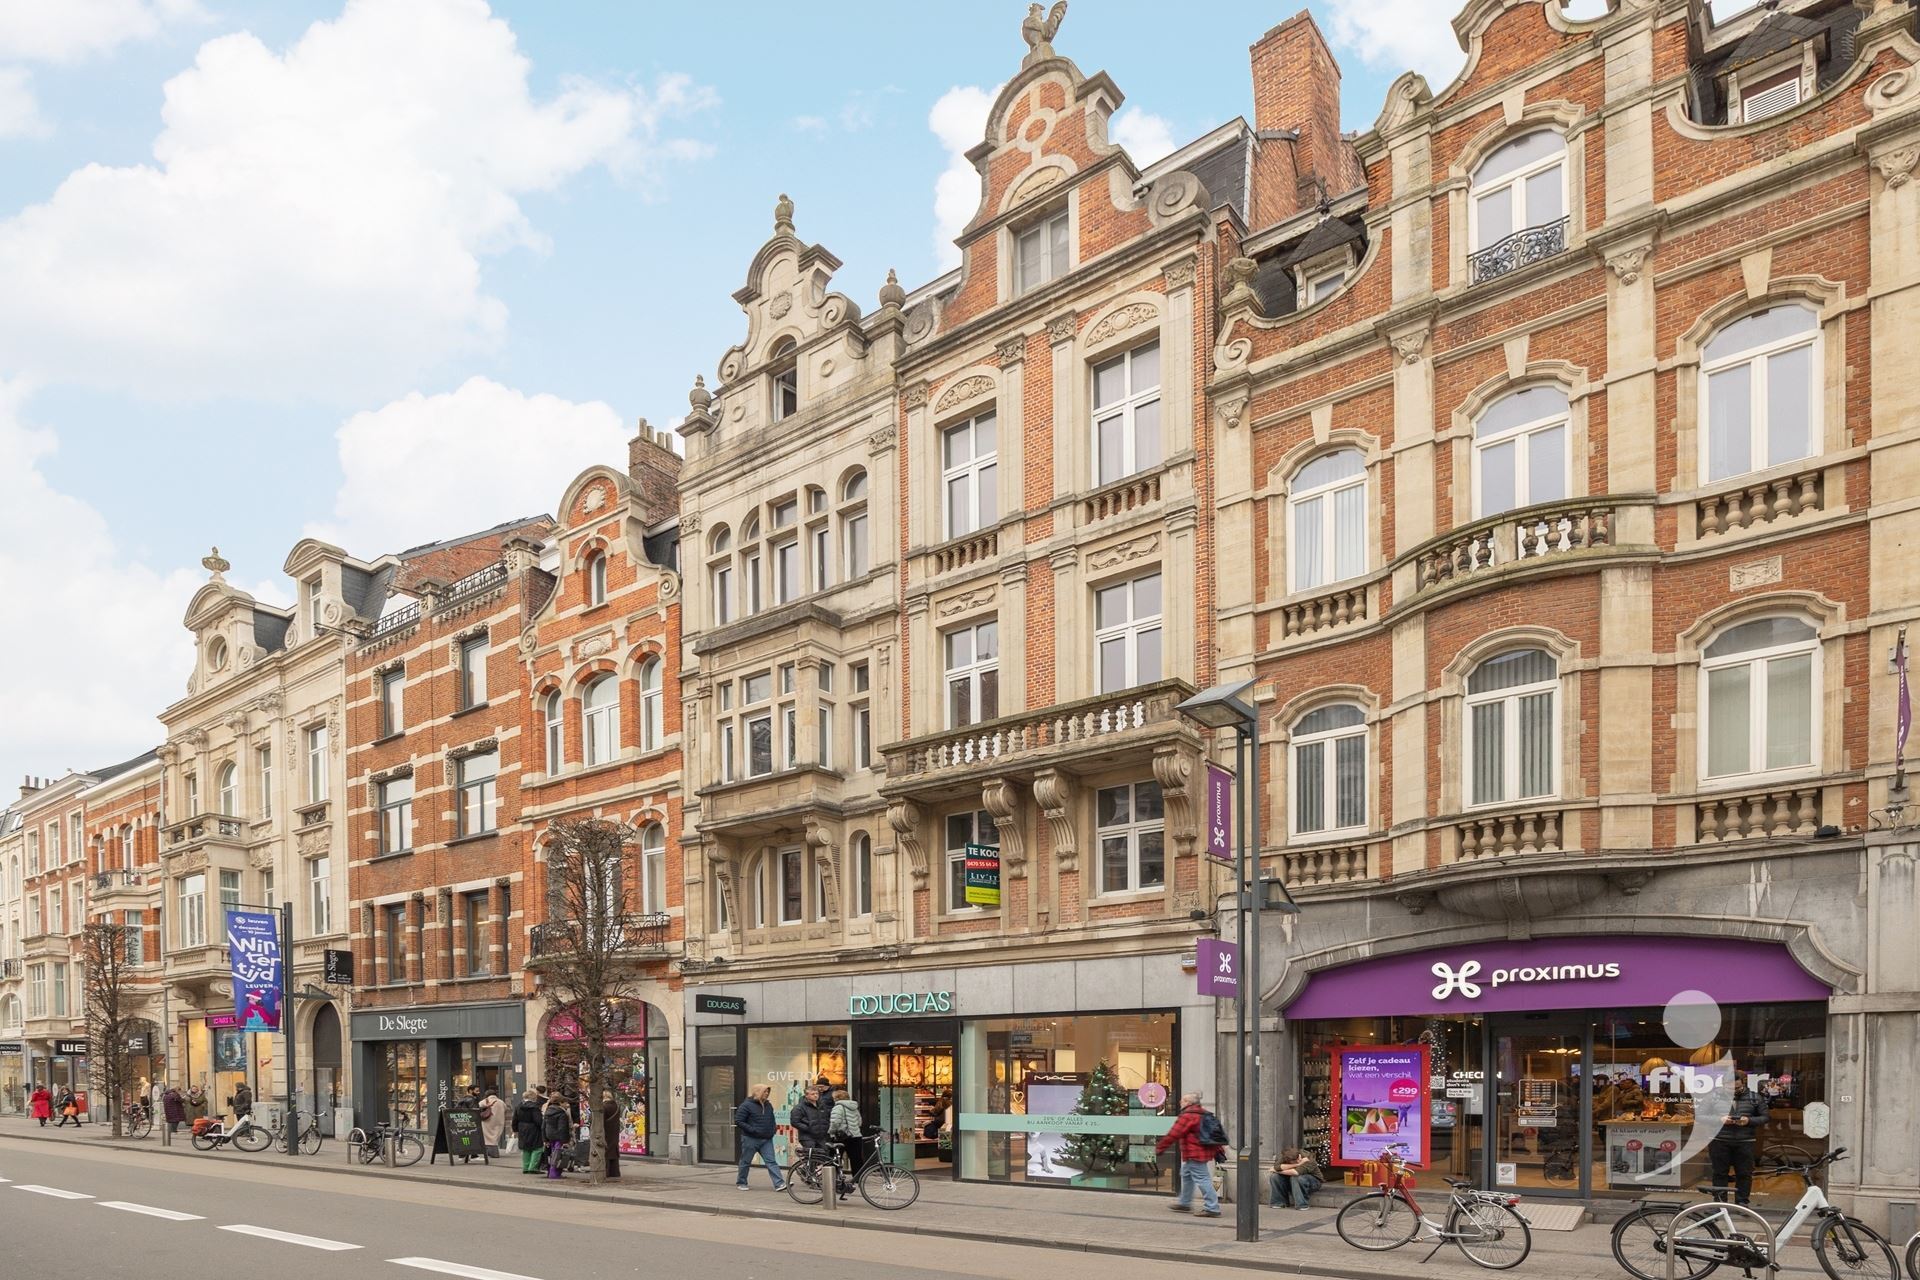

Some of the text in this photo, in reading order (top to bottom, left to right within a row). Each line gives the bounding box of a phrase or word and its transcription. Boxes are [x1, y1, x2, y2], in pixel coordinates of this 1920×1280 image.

[967, 847, 999, 858] TE KOO
[245, 952, 281, 966] ter
[232, 962, 275, 983] tijd
[327, 971, 337, 982] De
[1491, 962, 1621, 988] proximus
[1213, 975, 1237, 985] proximus
[706, 1000, 740, 1010] DOUGLAS
[850, 991, 951, 1015] DOUGLAS
[379, 1015, 428, 1035] De Slegte
[61, 1043, 87, 1052] WE
[1367, 1057, 1376, 1065] je
[767, 1071, 795, 1081] GIVE
[1646, 1066, 1770, 1094] fibr
[438, 1080, 448, 1101] Slegte
[1392, 1087, 1418, 1095] €299
